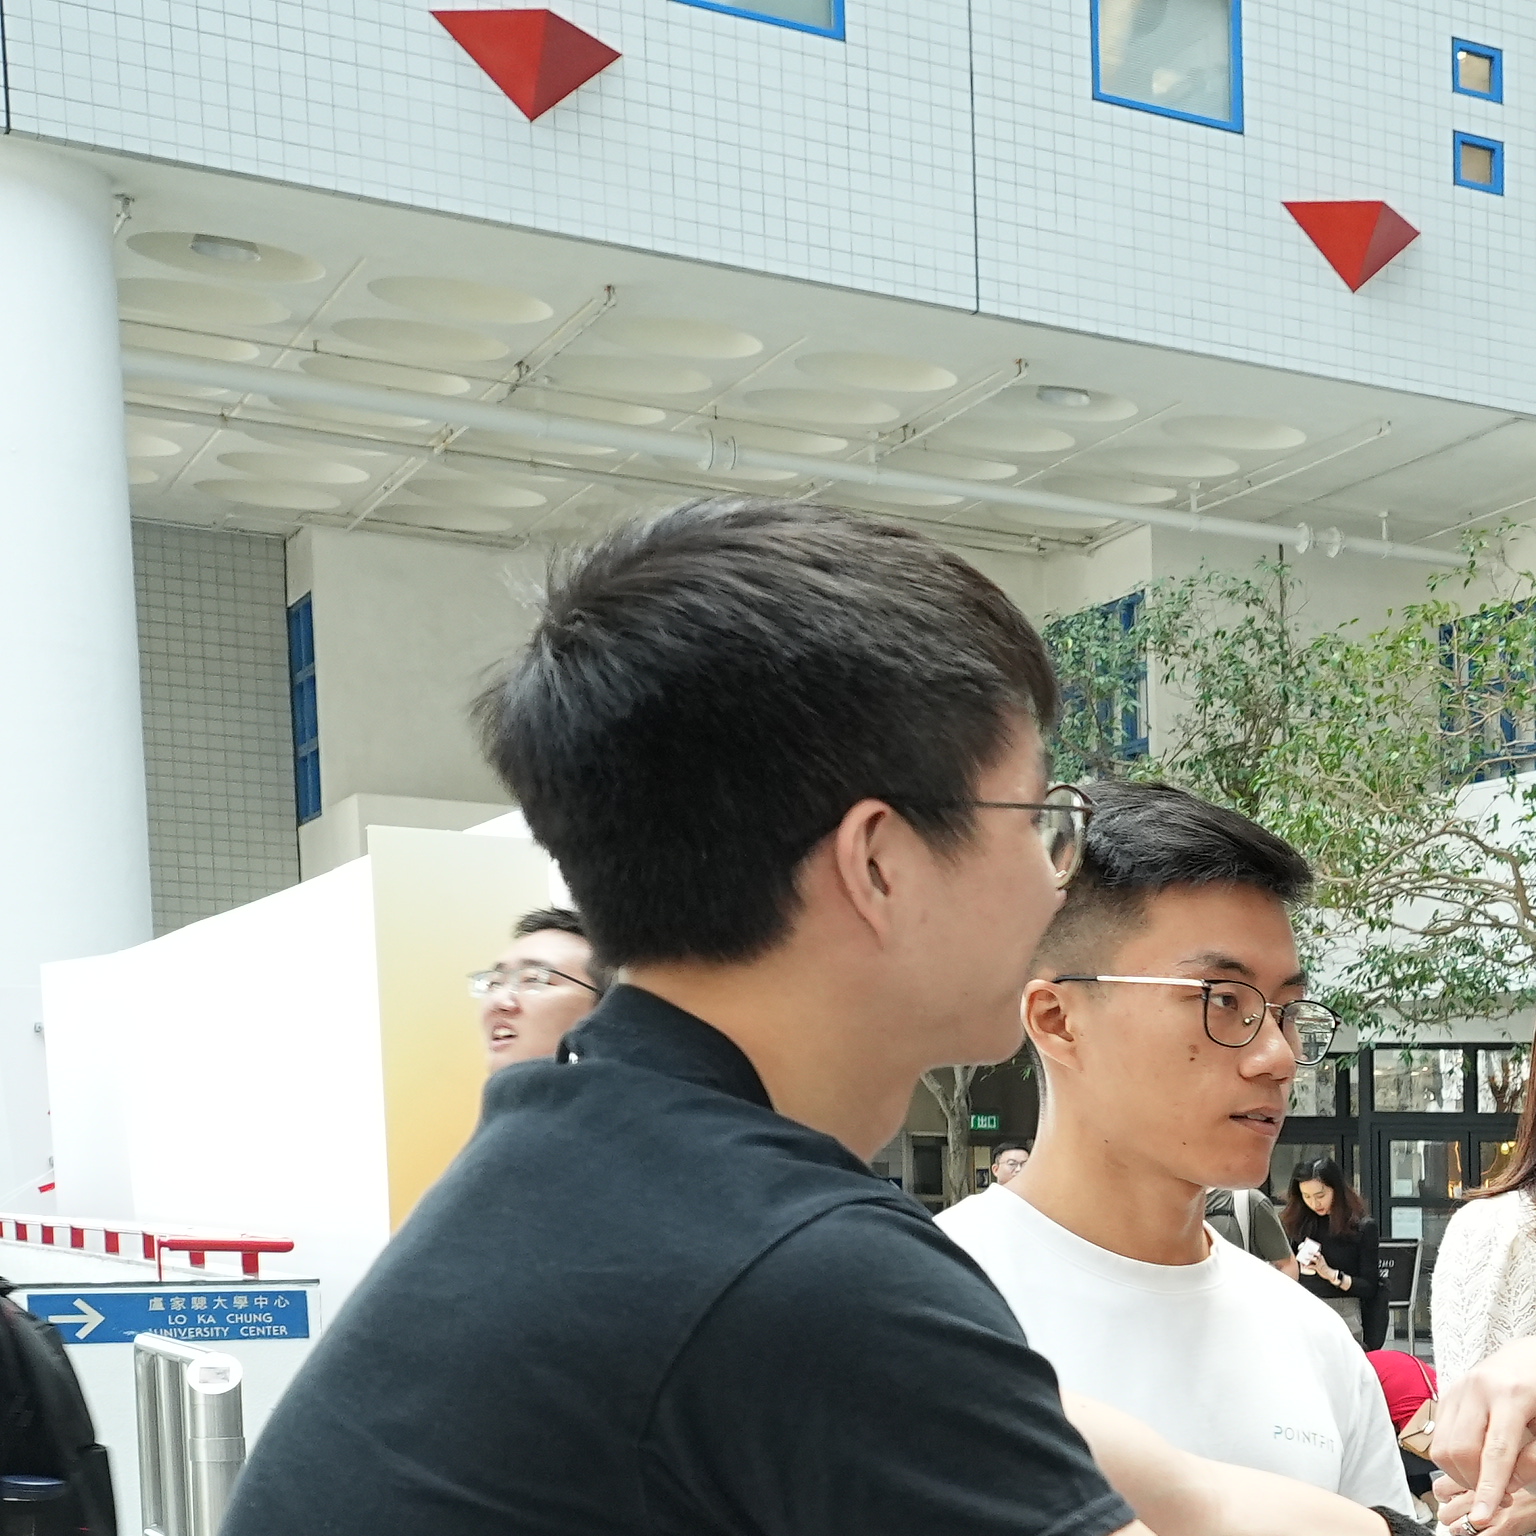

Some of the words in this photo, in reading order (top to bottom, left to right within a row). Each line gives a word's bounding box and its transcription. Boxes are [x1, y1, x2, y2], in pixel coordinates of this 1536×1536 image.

[978, 1115, 996, 1128] 出口
[168, 1314, 187, 1325] LO
[197, 1314, 216, 1324] KA
[226, 1313, 273, 1324] CHUNG
[239, 1325, 288, 1337] CENTER
[1273, 1425, 1335, 1453] POINTFIT
